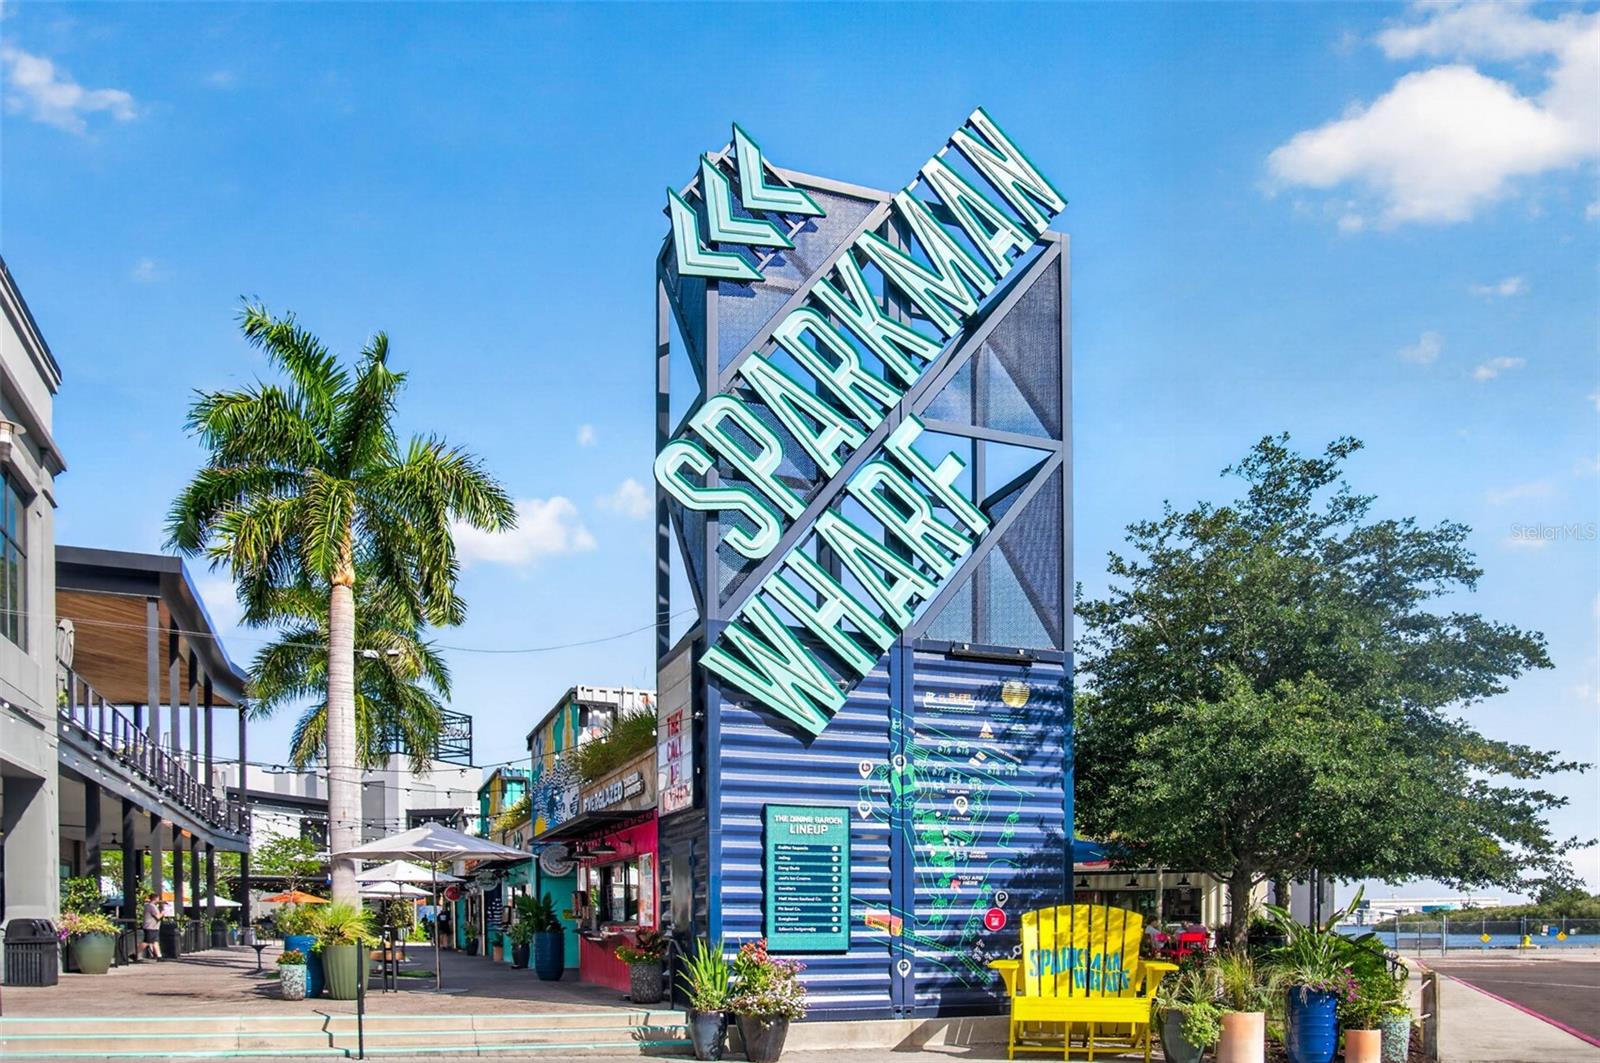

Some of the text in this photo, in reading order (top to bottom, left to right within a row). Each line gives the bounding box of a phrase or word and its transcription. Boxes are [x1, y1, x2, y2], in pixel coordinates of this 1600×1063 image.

[654, 106, 1067, 562] SPARKMAN
[699, 412, 990, 738] WHARF
[666, 708, 684, 738] THEY
[789, 824, 829, 835] LINEUP
[815, 816, 843, 825] GARDEN
